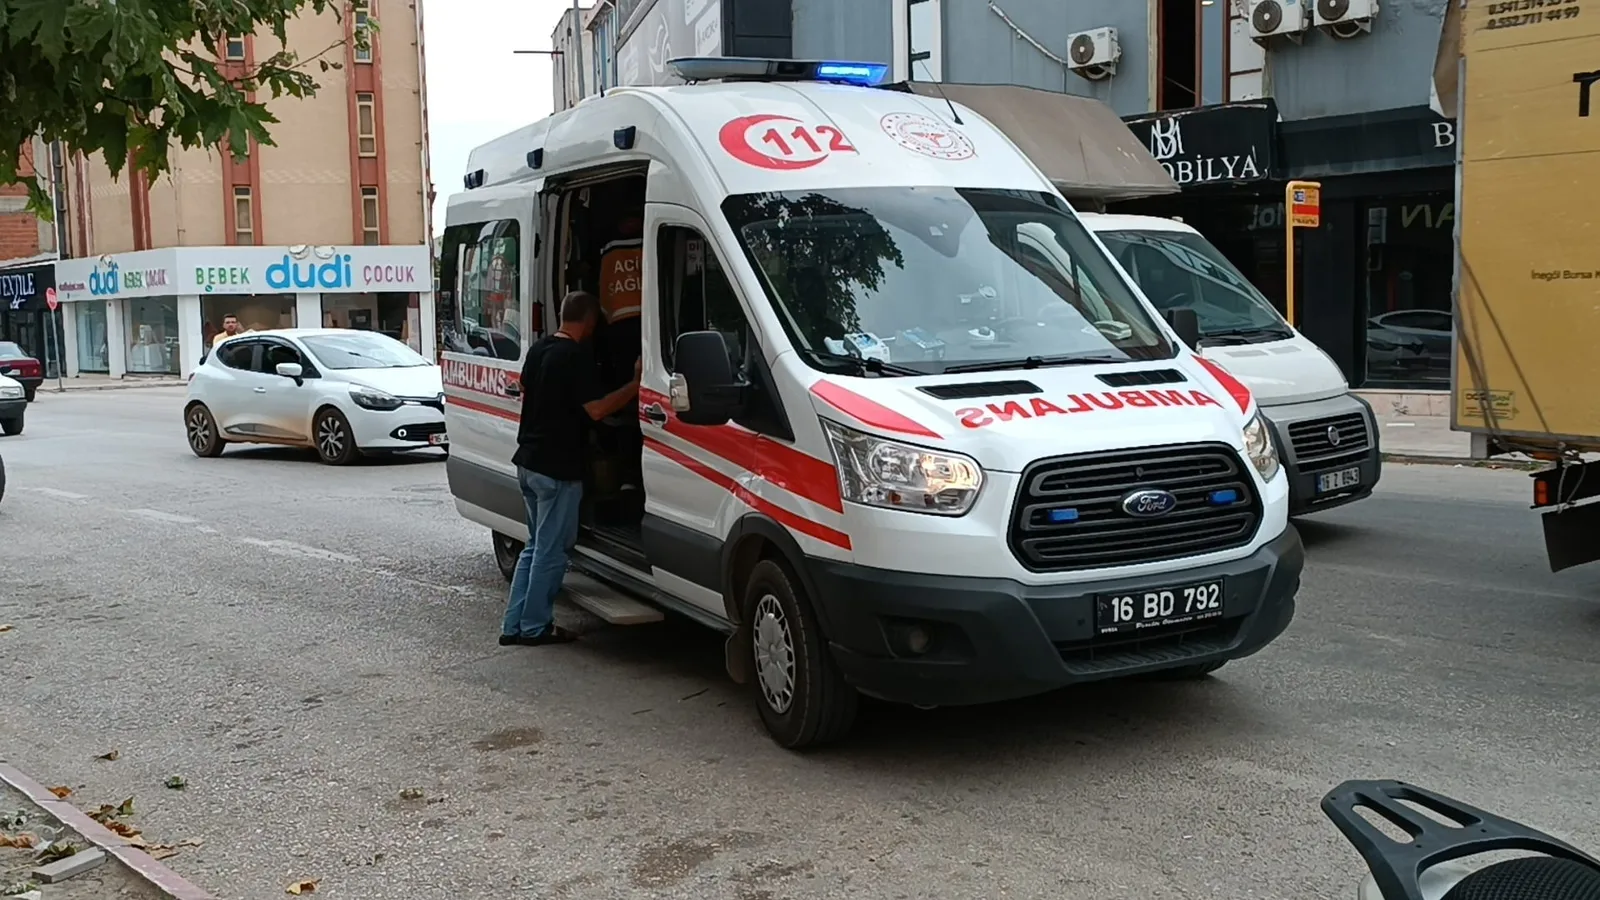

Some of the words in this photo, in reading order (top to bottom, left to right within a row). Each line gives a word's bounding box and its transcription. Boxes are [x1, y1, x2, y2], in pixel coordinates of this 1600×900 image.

[762, 125, 857, 156] 112
[89, 265, 119, 296] dudi
[195, 267, 250, 285] BEBEK
[265, 254, 352, 289] dudi
[363, 265, 415, 285] ÇOCUK
[442, 359, 507, 395] AMBULANS
[1137, 495, 1167, 511] Ford
[1111, 596, 1134, 622] 16
[1143, 591, 1175, 618] BD
[1184, 584, 1219, 612] 792
